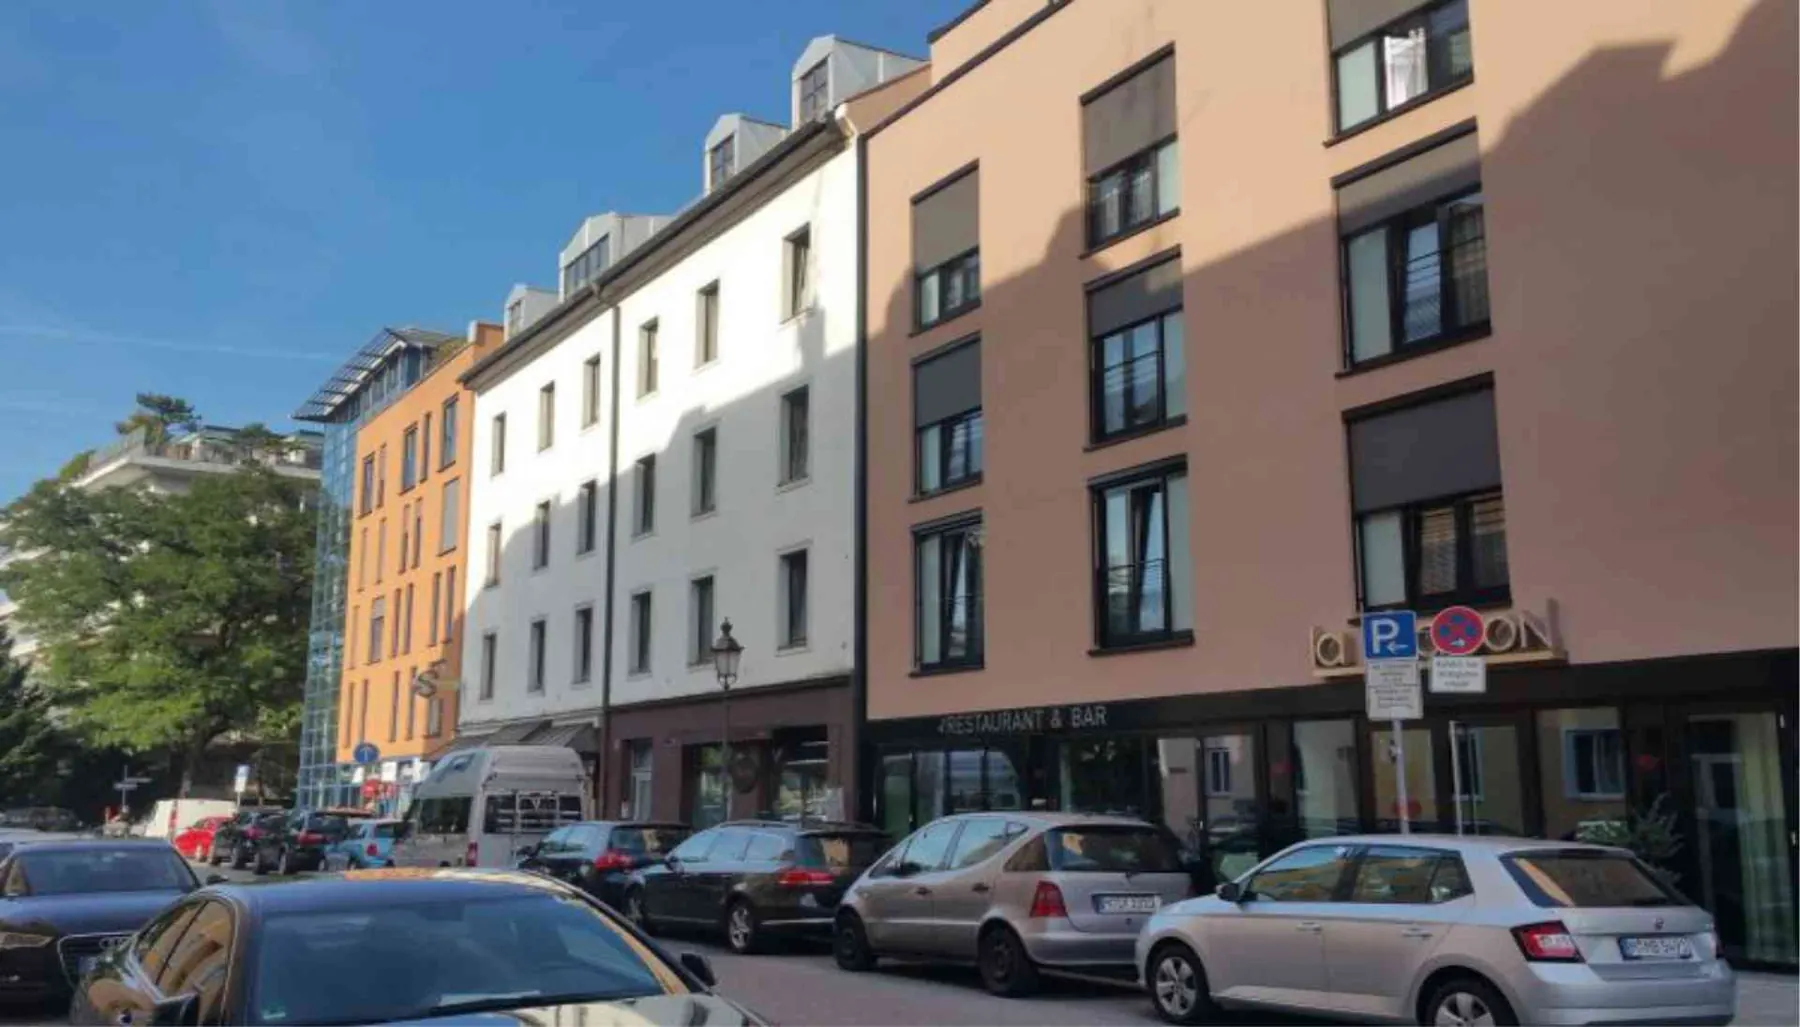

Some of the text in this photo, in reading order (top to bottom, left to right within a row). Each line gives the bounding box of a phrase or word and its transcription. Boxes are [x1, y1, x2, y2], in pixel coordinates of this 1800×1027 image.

[1371, 618, 1399, 653] P
[946, 705, 1108, 735] RESTAURANT & BAR
